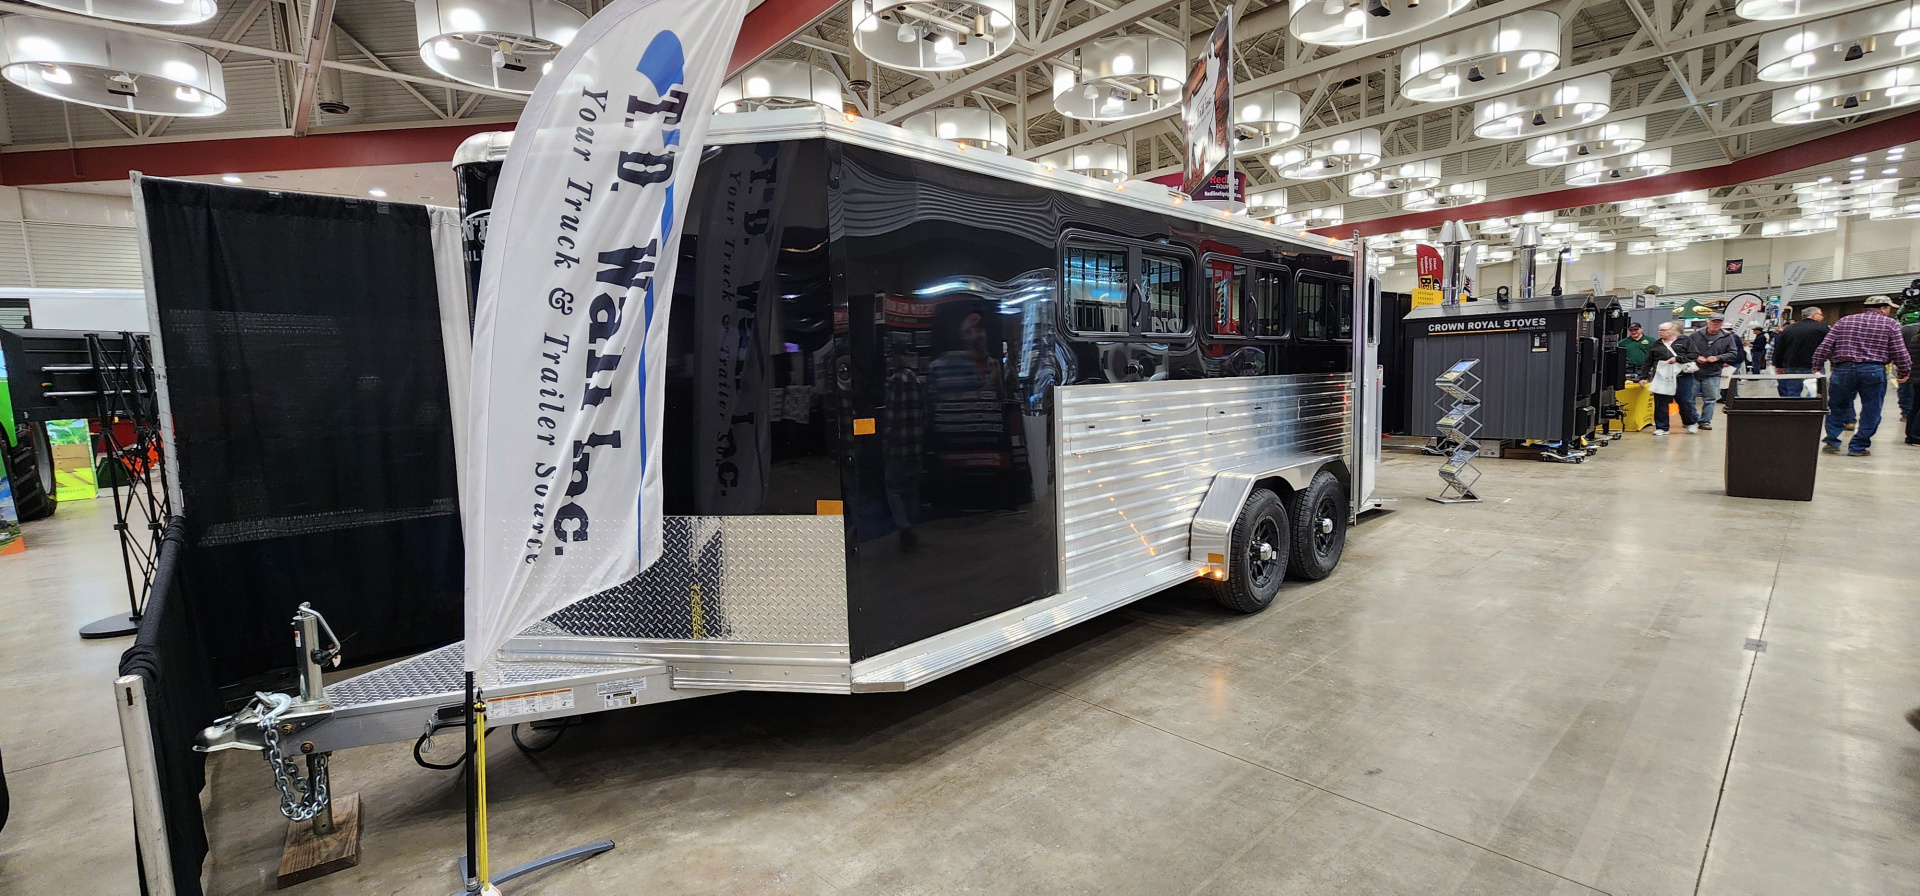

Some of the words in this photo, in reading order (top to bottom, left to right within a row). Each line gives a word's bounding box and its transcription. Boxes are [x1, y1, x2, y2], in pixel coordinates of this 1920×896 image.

[572, 85, 609, 162] Your
[610, 88, 689, 191] T.D.
[553, 176, 594, 270] Truck
[548, 287, 575, 316] &
[580, 238, 658, 411] Wall
[1428, 322, 1465, 332] CROWN
[1467, 320, 1501, 330] ROYAL
[1503, 317, 1547, 328] STOVES
[536, 331, 570, 446] Trailer
[524, 461, 557, 565] Source
[553, 430, 622, 556] Inc.
